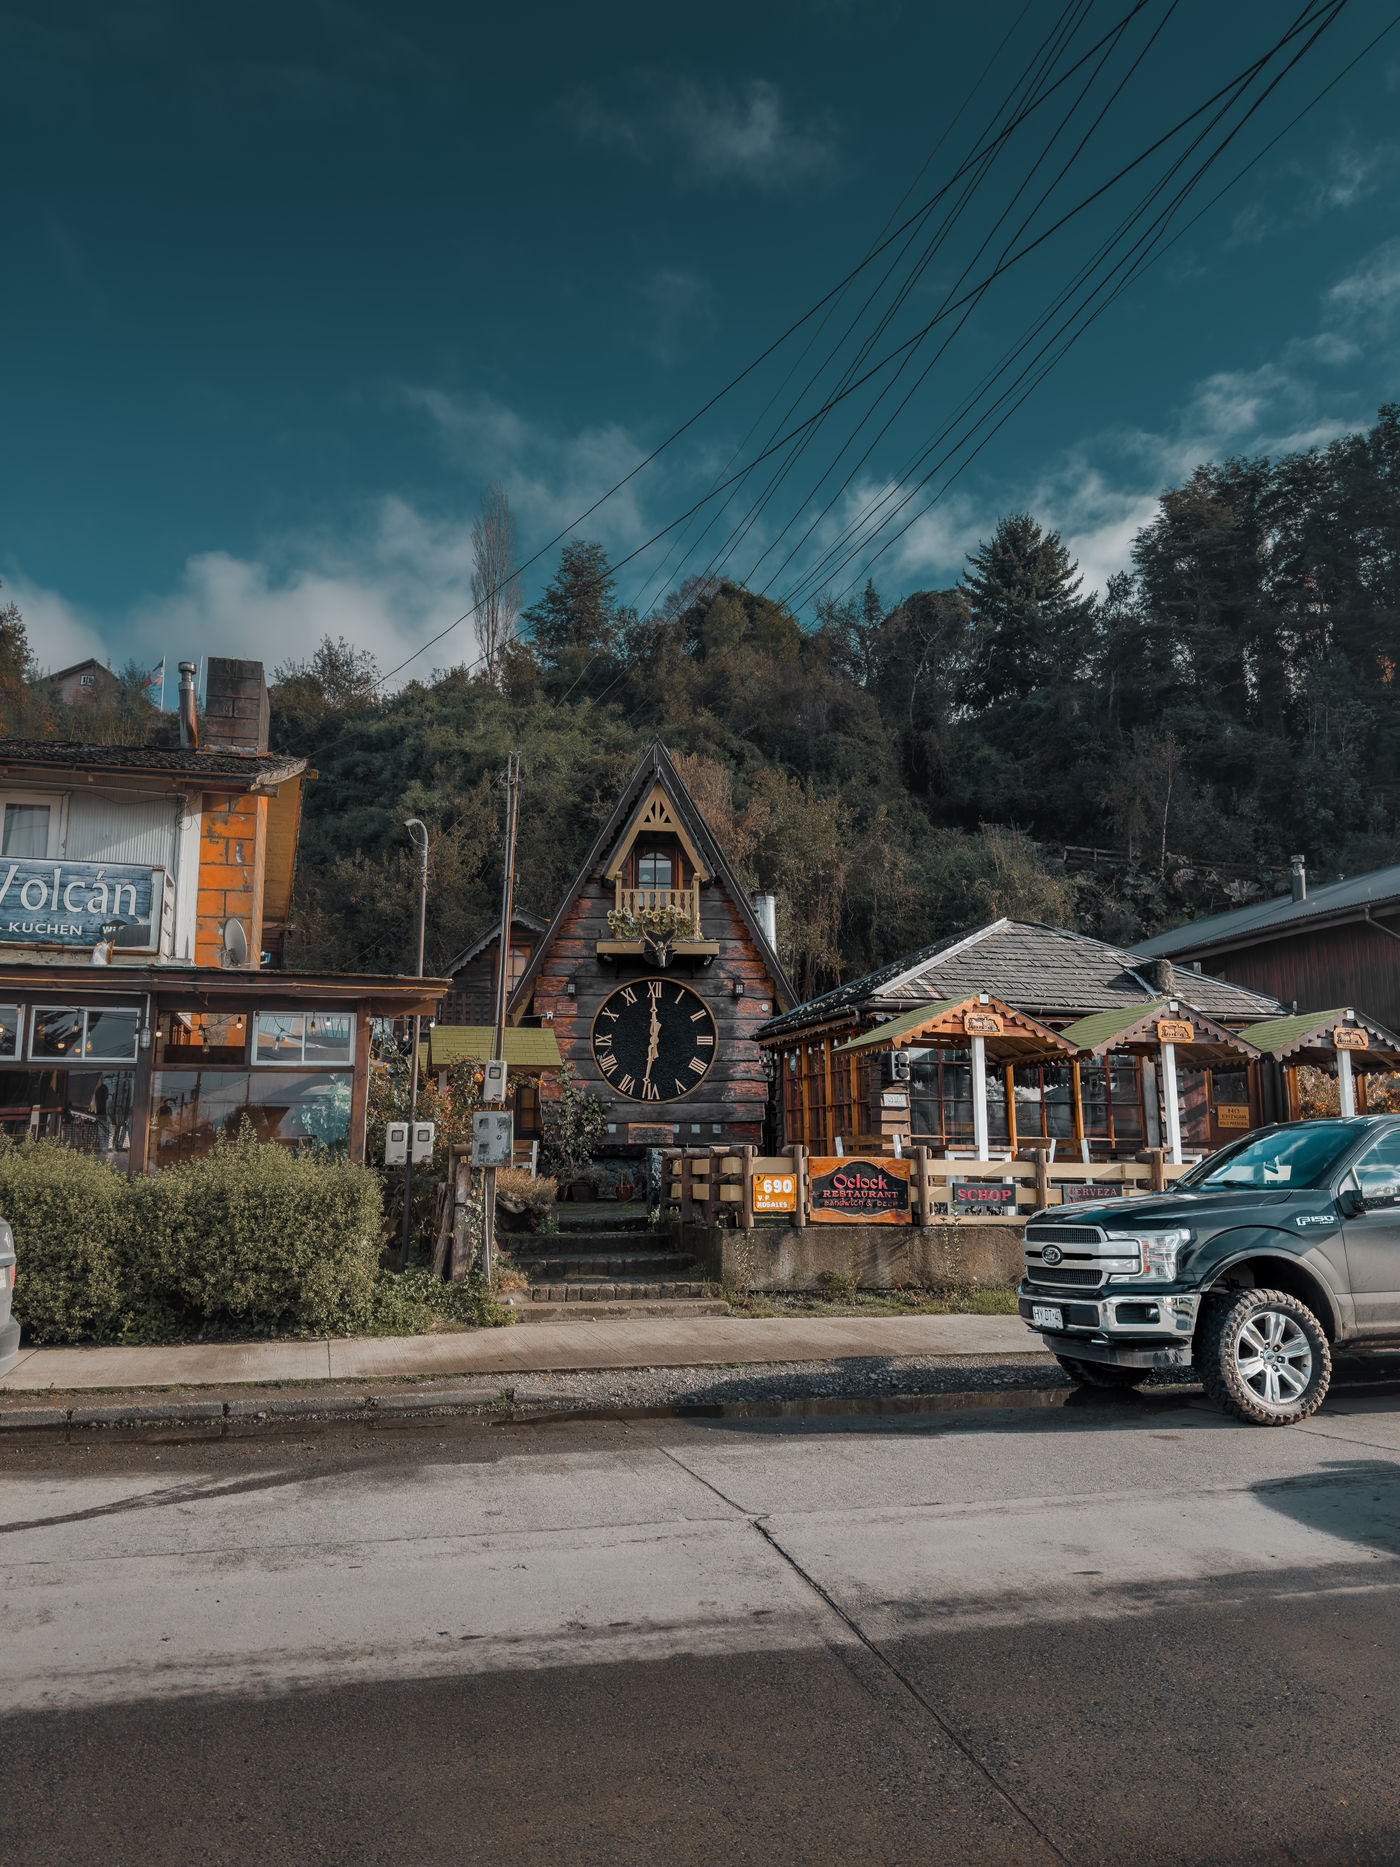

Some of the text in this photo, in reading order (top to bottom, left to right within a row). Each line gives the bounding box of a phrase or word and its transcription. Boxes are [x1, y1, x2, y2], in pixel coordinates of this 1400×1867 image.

[8, 921, 83, 936] KUCHEN
[763, 1179, 793, 1193] 690
[1068, 1187, 1117, 1196] CERVEZA
[822, 1189, 899, 1199] RESTAURANT
[957, 1188, 1012, 1201] SCHOP
